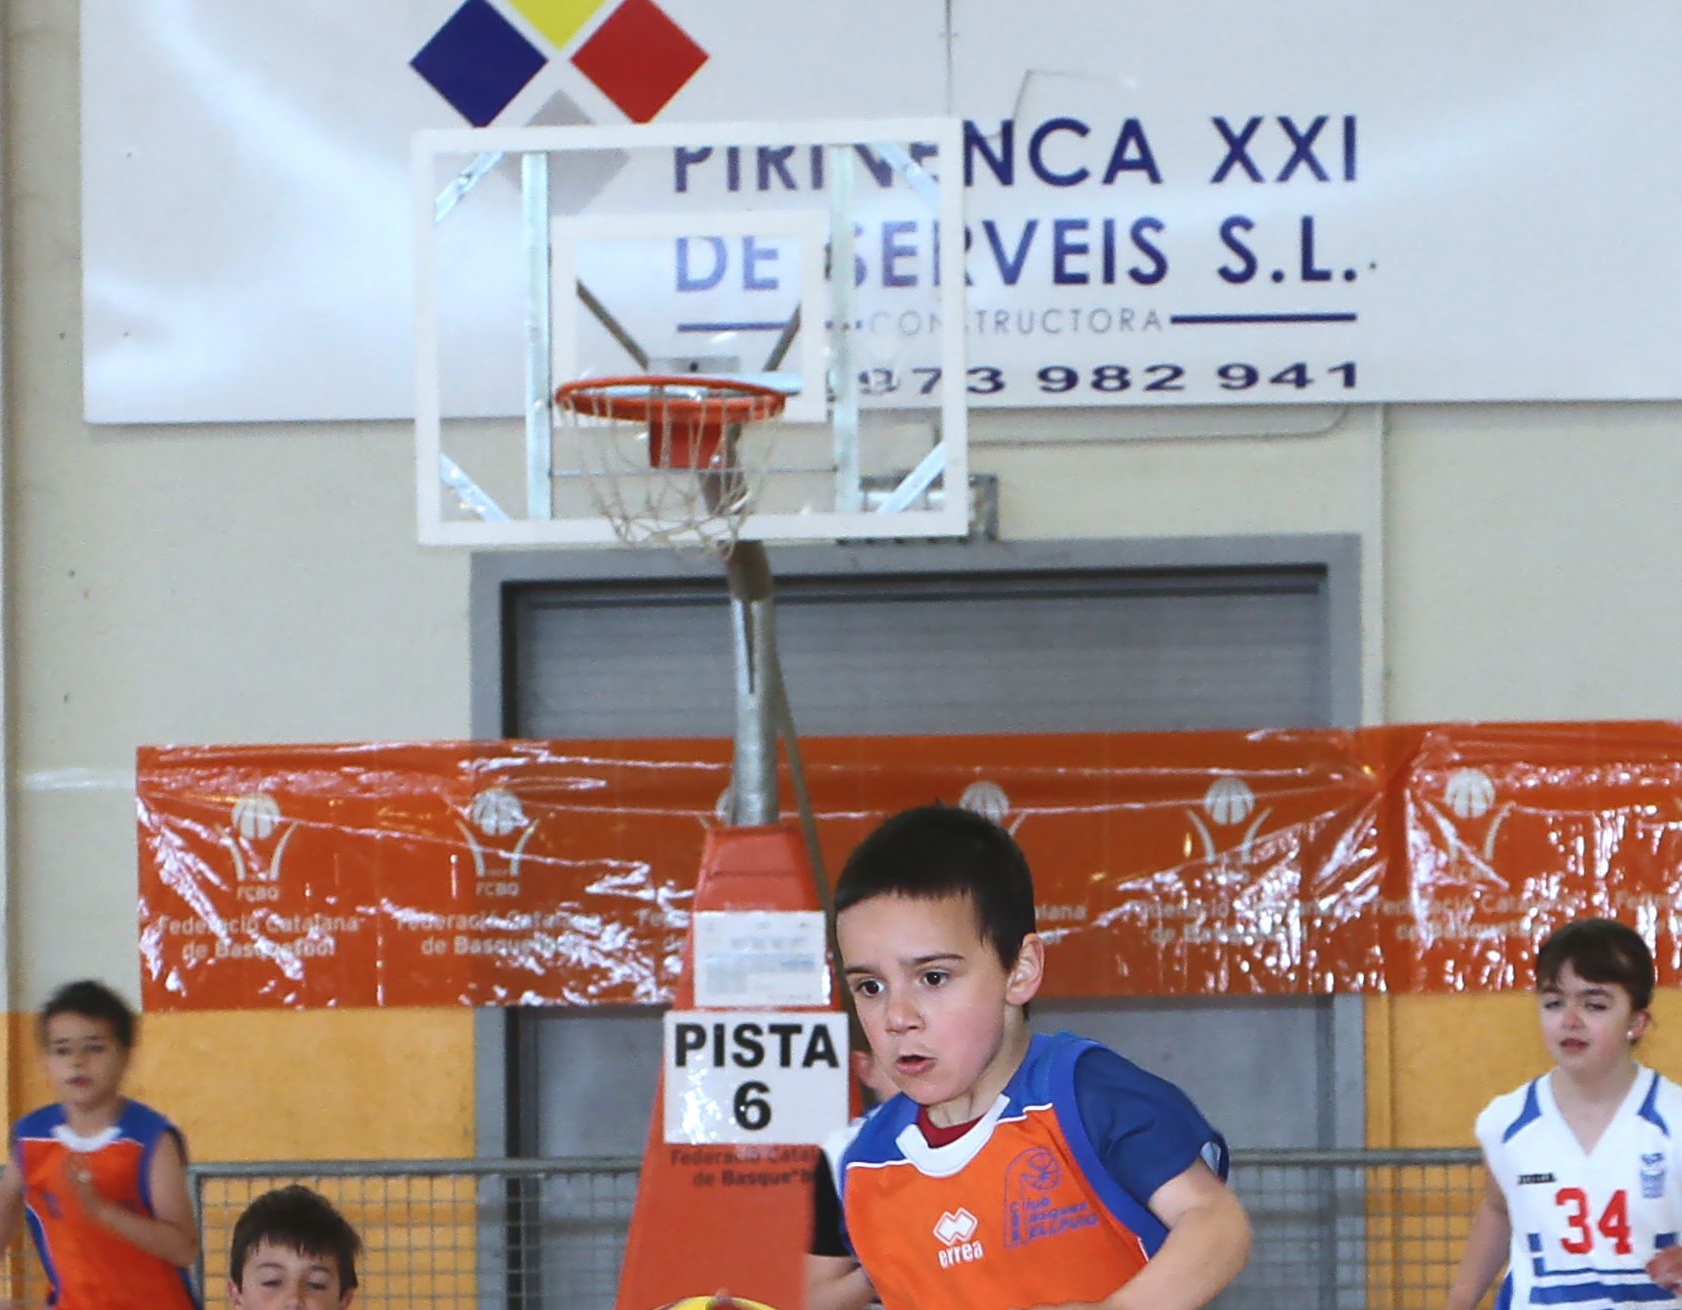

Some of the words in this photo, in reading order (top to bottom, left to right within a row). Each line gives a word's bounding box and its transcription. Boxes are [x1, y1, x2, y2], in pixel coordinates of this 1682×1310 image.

[1210, 114, 1357, 184] XXI
[675, 235, 780, 292] DE
[1217, 214, 1358, 285] S.L.
[869, 306, 1163, 336] CONTRUCTORA
[1036, 364, 1185, 393] 982
[1214, 360, 1357, 391] 941
[674, 1022, 840, 1069] PISTA
[733, 1080, 772, 1131] 6
[1554, 1187, 1633, 1255] 34
[937, 1240, 984, 1269] errea
